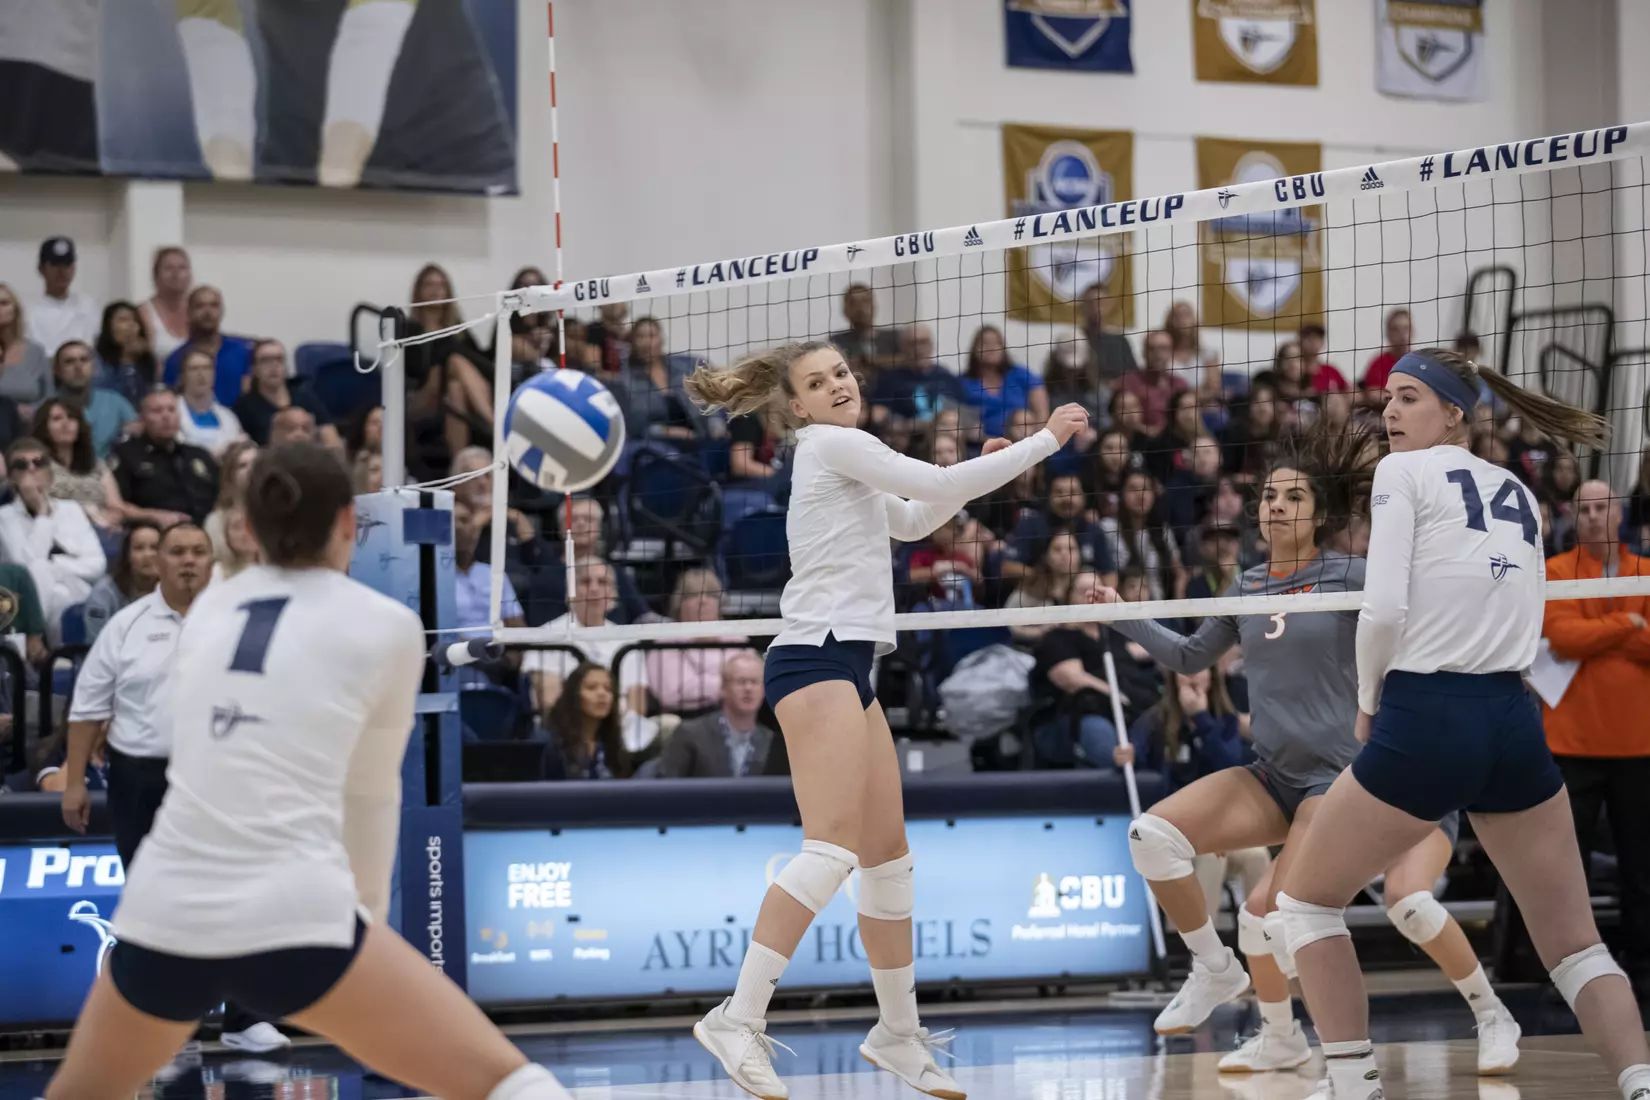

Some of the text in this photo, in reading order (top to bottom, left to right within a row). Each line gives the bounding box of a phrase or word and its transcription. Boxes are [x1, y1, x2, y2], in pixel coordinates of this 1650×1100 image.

[574, 277, 611, 302] CBU
[675, 247, 818, 289] #LANCEUP
[894, 230, 935, 257] CBU
[1013, 193, 1184, 241] #LANCEUP
[1274, 172, 1325, 204] CBU
[1360, 179, 1385, 191] adidas
[1420, 126, 1628, 182] #LANCEUP
[1445, 468, 1538, 548] 14
[226, 595, 292, 675] 1
[1264, 612, 1287, 640] 3
[425, 835, 444, 897] sports
[508, 862, 572, 882] ENJOY
[508, 882, 572, 909] FREE
[1060, 875, 1126, 910] CBU
